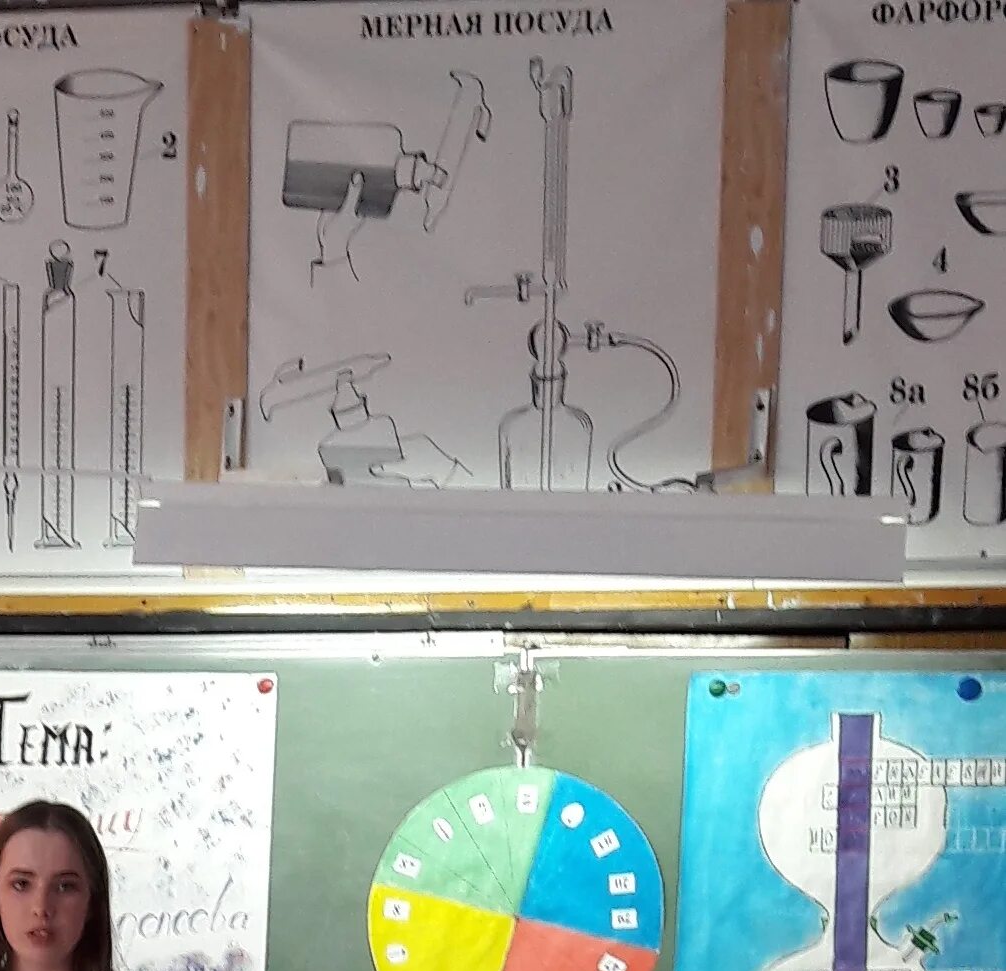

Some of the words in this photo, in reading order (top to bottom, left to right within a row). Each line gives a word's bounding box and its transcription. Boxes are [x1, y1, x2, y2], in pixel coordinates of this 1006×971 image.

[361, 11, 482, 38] МЕРНАЯ
[494, 8, 613, 35] ПОСУДА
[872, 0, 1006, 24] ФАРФОР
[162, 131, 177, 159] 2
[883, 165, 900, 193] 3
[94, 249, 108, 276] 7
[932, 245, 948, 273] 4
[889, 376, 925, 404] 8а
